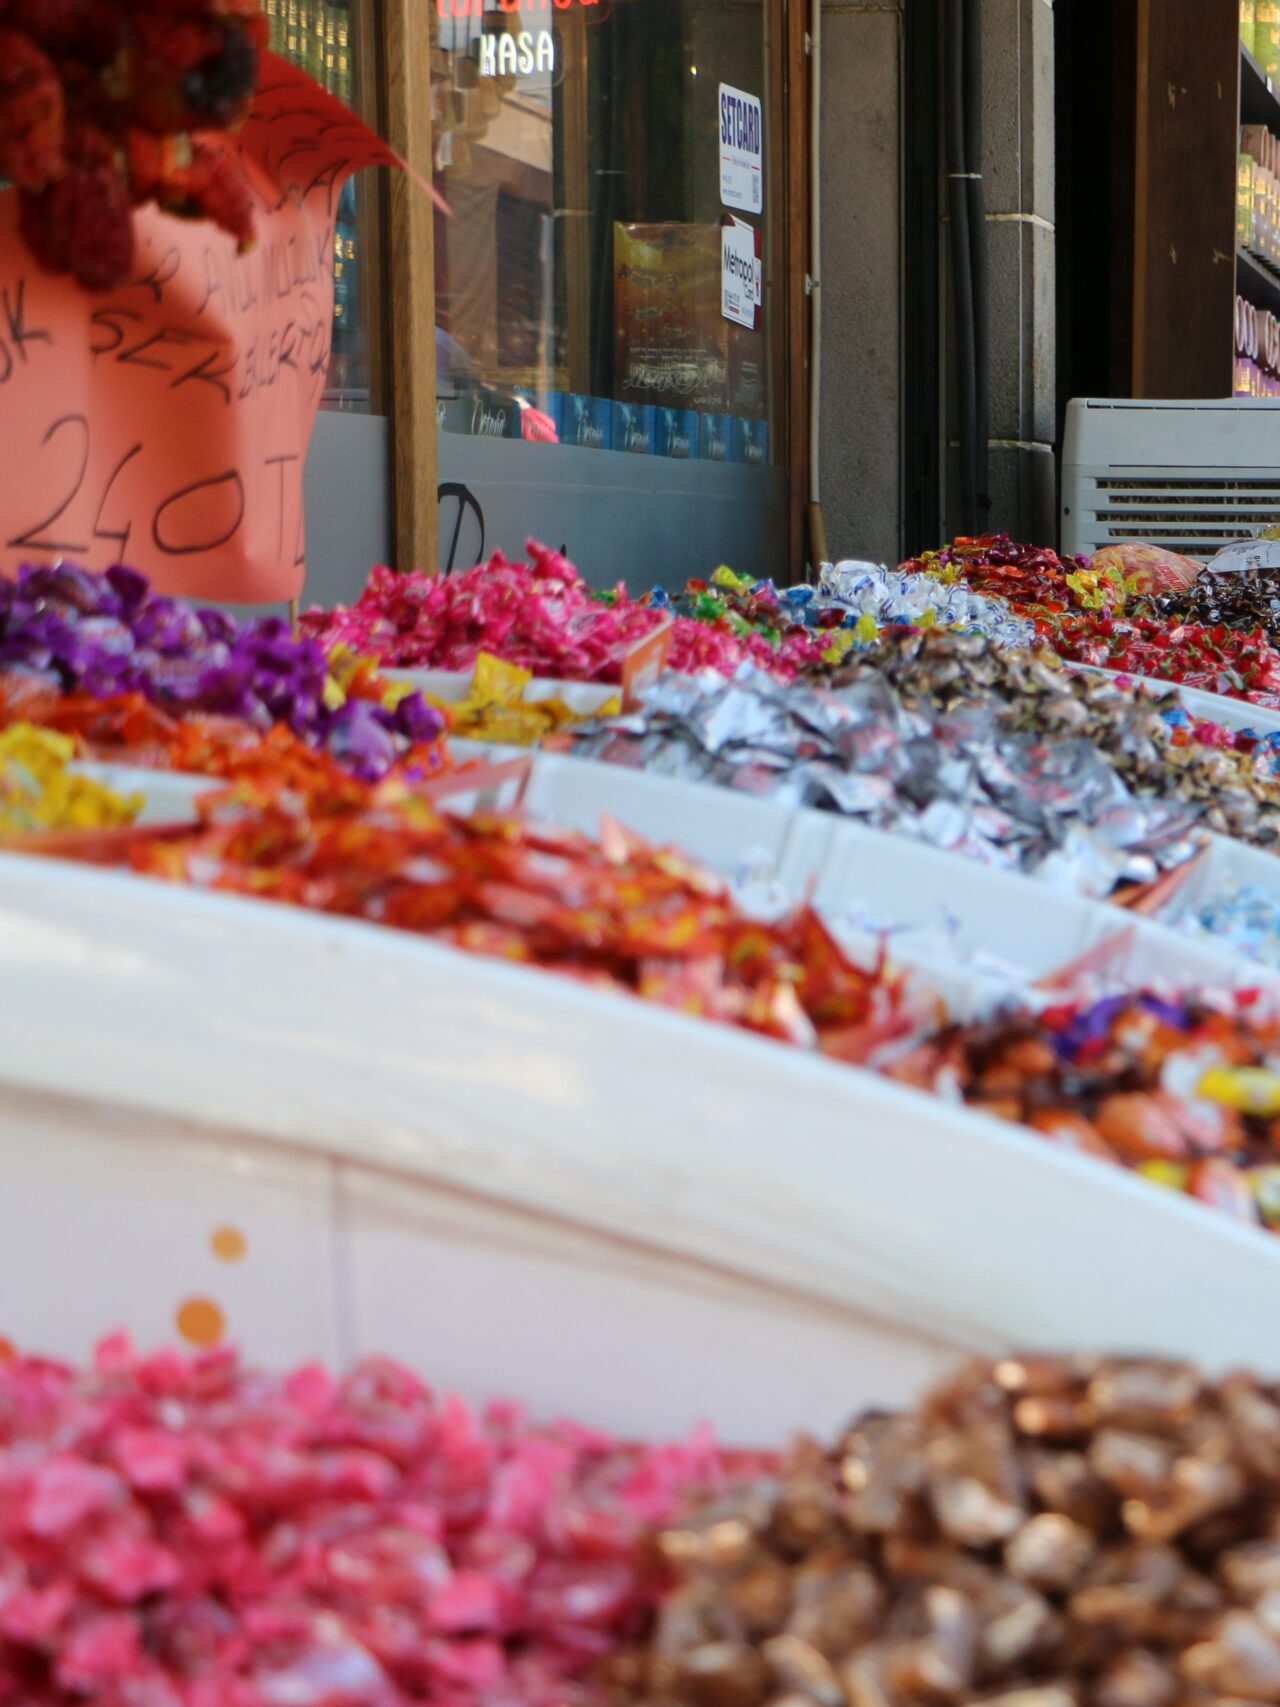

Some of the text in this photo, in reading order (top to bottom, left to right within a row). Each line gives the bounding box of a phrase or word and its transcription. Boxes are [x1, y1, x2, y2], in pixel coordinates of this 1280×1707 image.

[480, 30, 554, 77] KASA
[721, 92, 760, 155] SETCARD
[723, 243, 754, 284] Metropol
